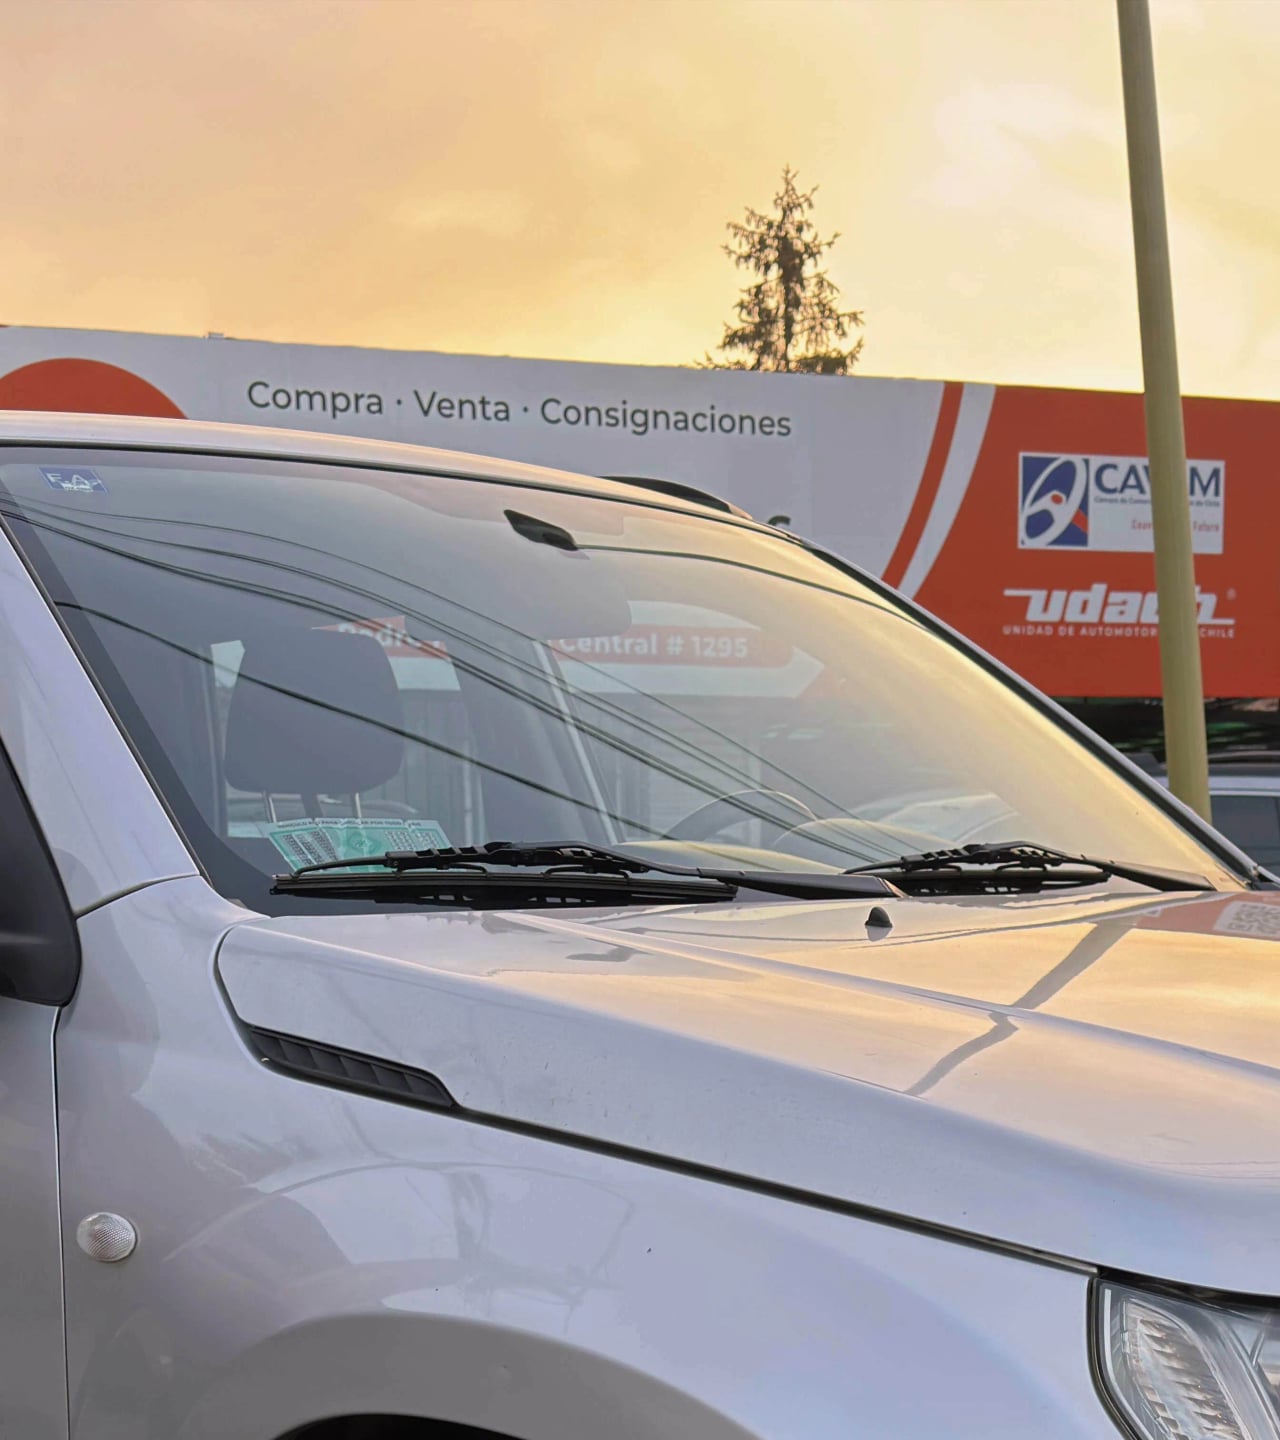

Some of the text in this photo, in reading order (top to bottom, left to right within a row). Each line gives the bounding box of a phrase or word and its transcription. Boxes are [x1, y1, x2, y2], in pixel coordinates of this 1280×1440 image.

[247, 381, 384, 418] Compra
[413, 389, 510, 422] Venta
[540, 398, 792, 437] Consignaciones
[1094, 463, 1221, 498] CAM
[1003, 626, 1235, 638] UNIDAD DE AUTOMOTOR CHILE
[691, 636, 748, 658] 1295
